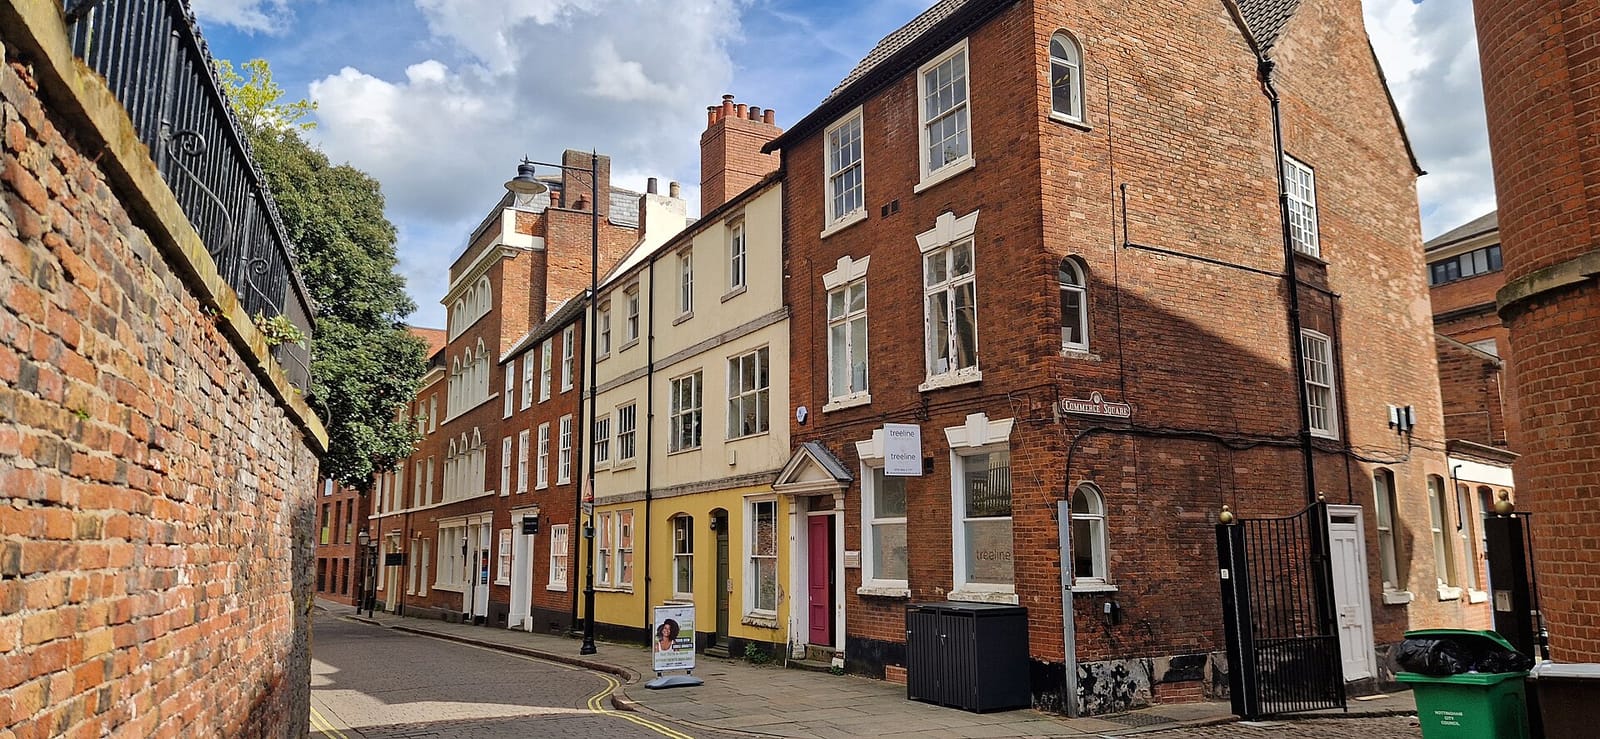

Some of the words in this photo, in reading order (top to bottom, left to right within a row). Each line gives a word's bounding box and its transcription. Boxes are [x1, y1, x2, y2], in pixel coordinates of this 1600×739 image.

[1065, 400, 1100, 413] COMMERCE
[1103, 404, 1129, 416] SQUARE
[976, 549, 1011, 561] treeline
